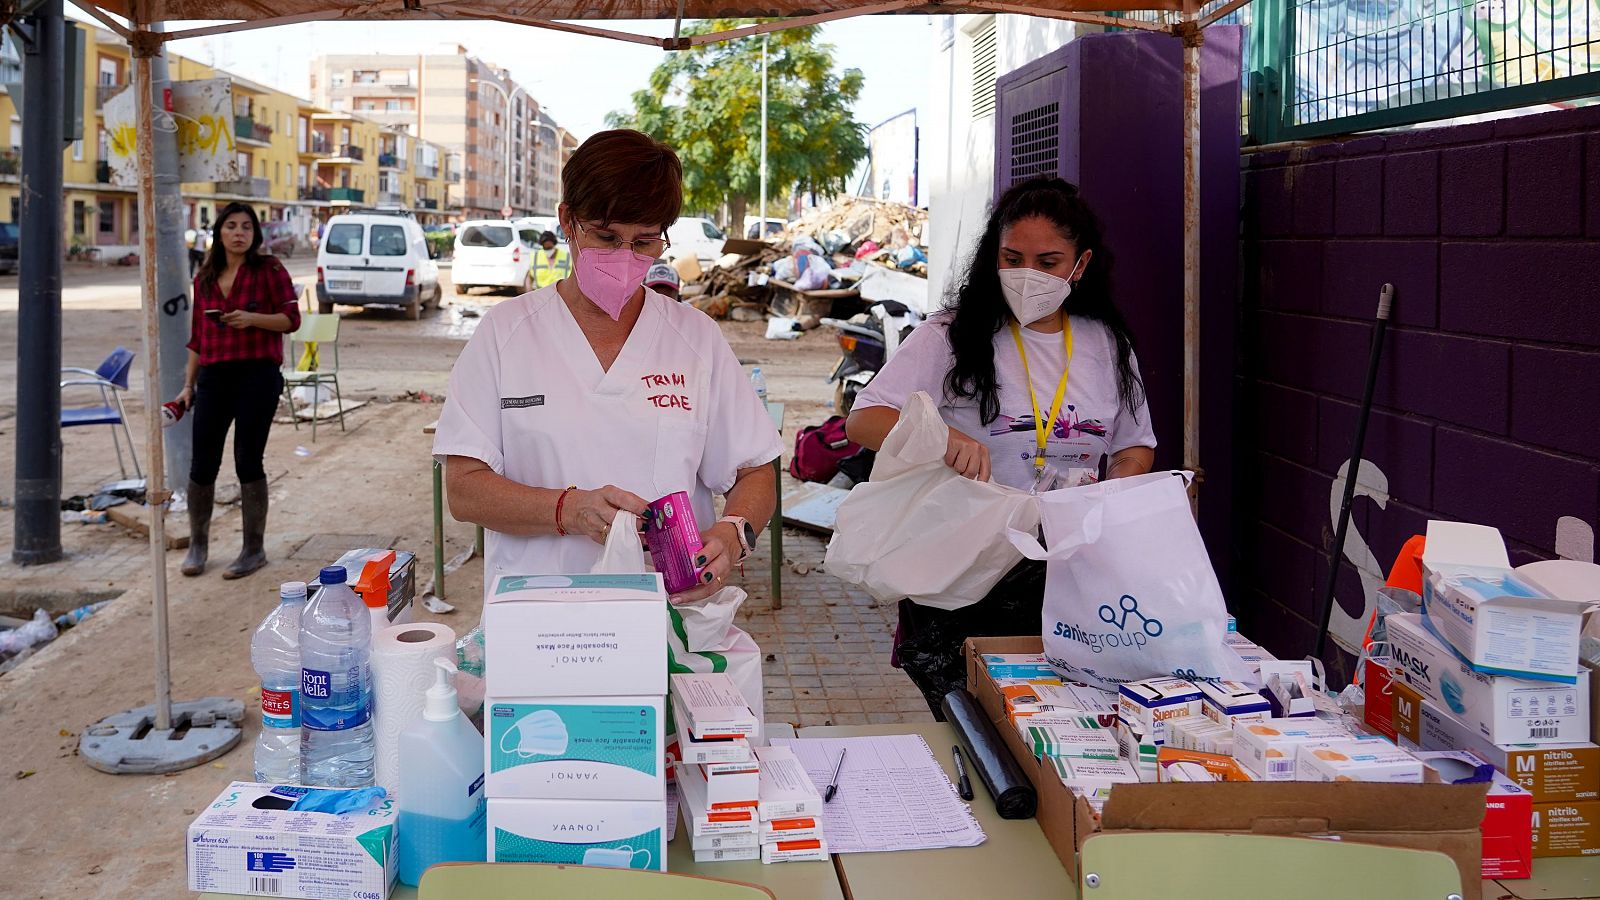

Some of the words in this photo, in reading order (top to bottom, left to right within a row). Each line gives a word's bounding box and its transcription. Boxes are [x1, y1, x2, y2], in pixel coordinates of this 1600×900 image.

[647, 394, 692, 411] TCAE
[1053, 620, 1147, 653] sanisgroup
[536, 643, 556, 651] Mask
[576, 642, 618, 650] Disposable
[1391, 643, 1431, 683] MASK
[303, 671, 327, 685] Font
[303, 682, 328, 697] Vella
[1399, 696, 1411, 719] M
[1544, 750, 1573, 760] nitrilo
[1516, 755, 1536, 772] M
[551, 772, 599, 780] YAANQI
[1518, 778, 1534, 786] 7-8
[226, 792, 241, 802] S
[213, 801, 237, 809] 6-7
[380, 799, 395, 810] S
[368, 808, 393, 818] 6-7
[1548, 806, 1578, 816] nitrilo
[363, 892, 380, 900] 0465
